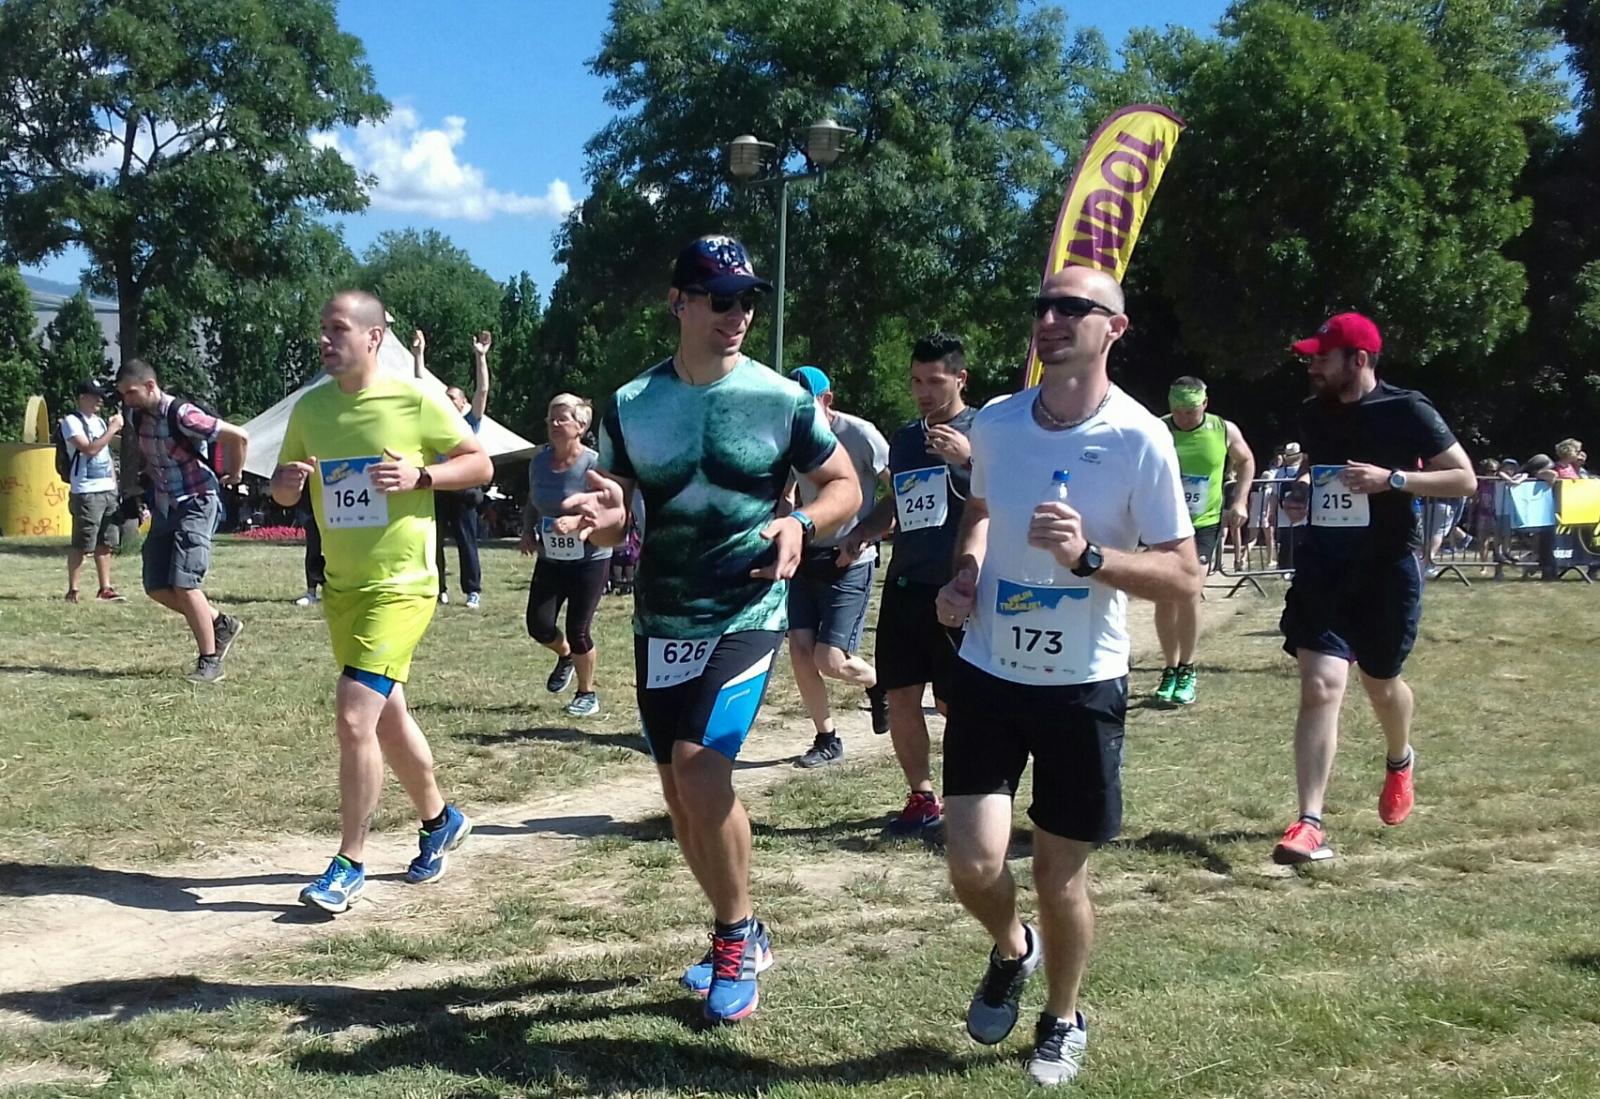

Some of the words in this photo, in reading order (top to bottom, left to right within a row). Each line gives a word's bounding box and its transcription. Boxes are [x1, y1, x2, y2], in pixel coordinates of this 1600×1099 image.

[334, 488, 371, 508] 164
[905, 494, 935, 514] 243
[1323, 493, 1352, 509] 215
[550, 536, 575, 549] 388
[1011, 626, 1064, 655] 173
[663, 641, 709, 664] 626
